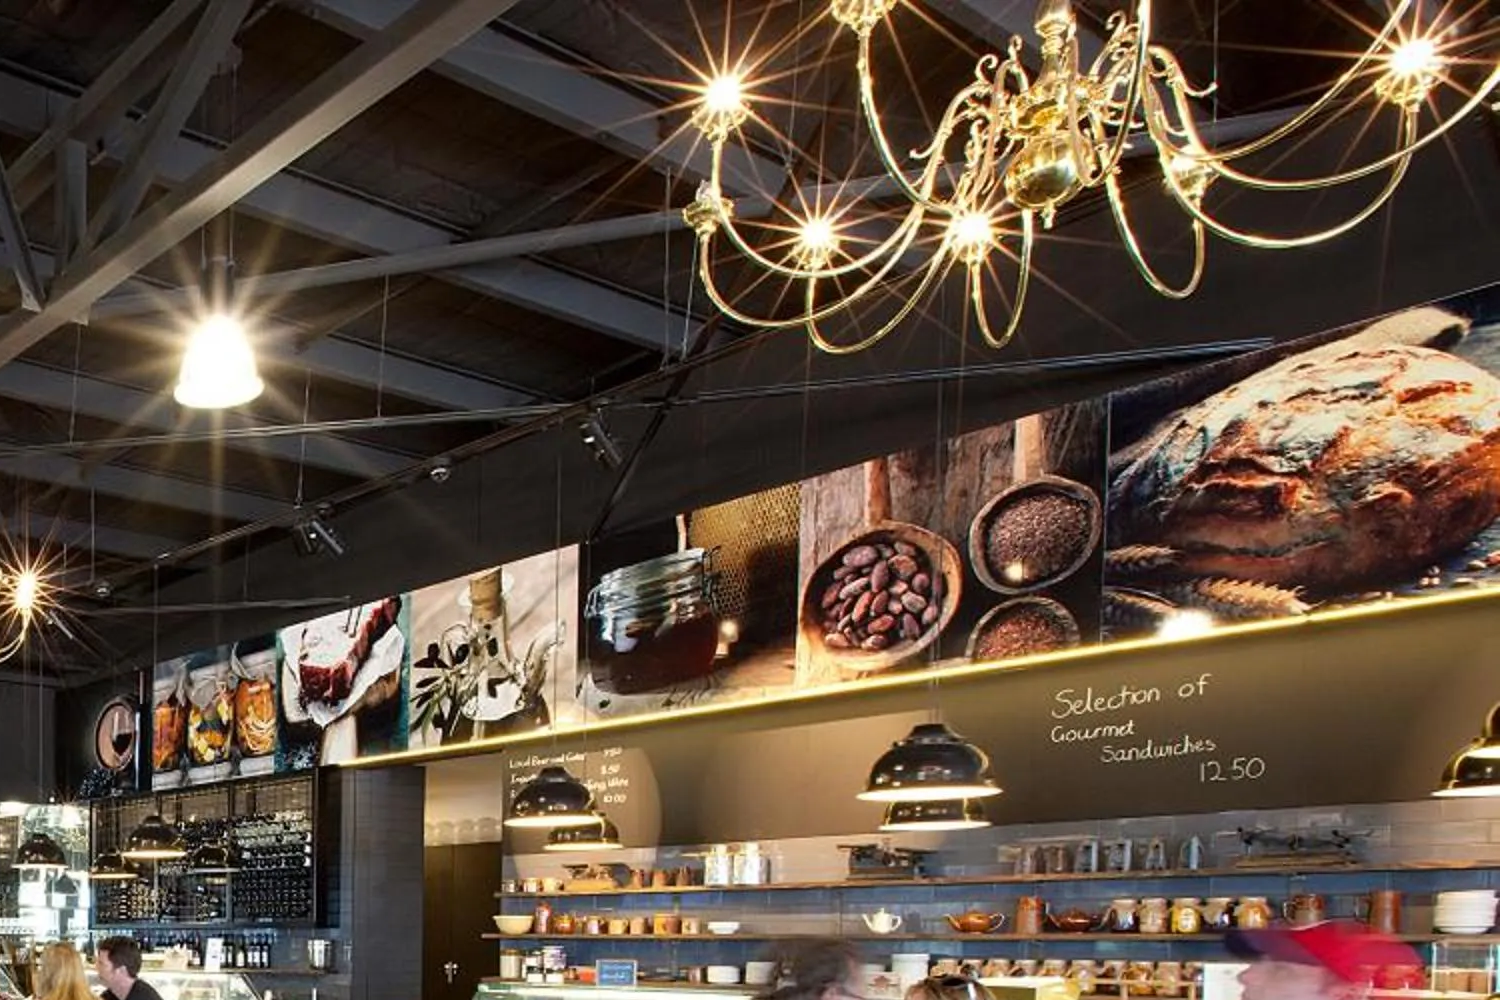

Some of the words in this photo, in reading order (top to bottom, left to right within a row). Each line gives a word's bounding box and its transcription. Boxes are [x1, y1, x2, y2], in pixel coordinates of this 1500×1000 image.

[1051, 687, 1160, 718] Selection
[1178, 673, 1212, 698] of
[1051, 719, 1135, 743] Gourmet
[1101, 736, 1216, 762] Sandwiches
